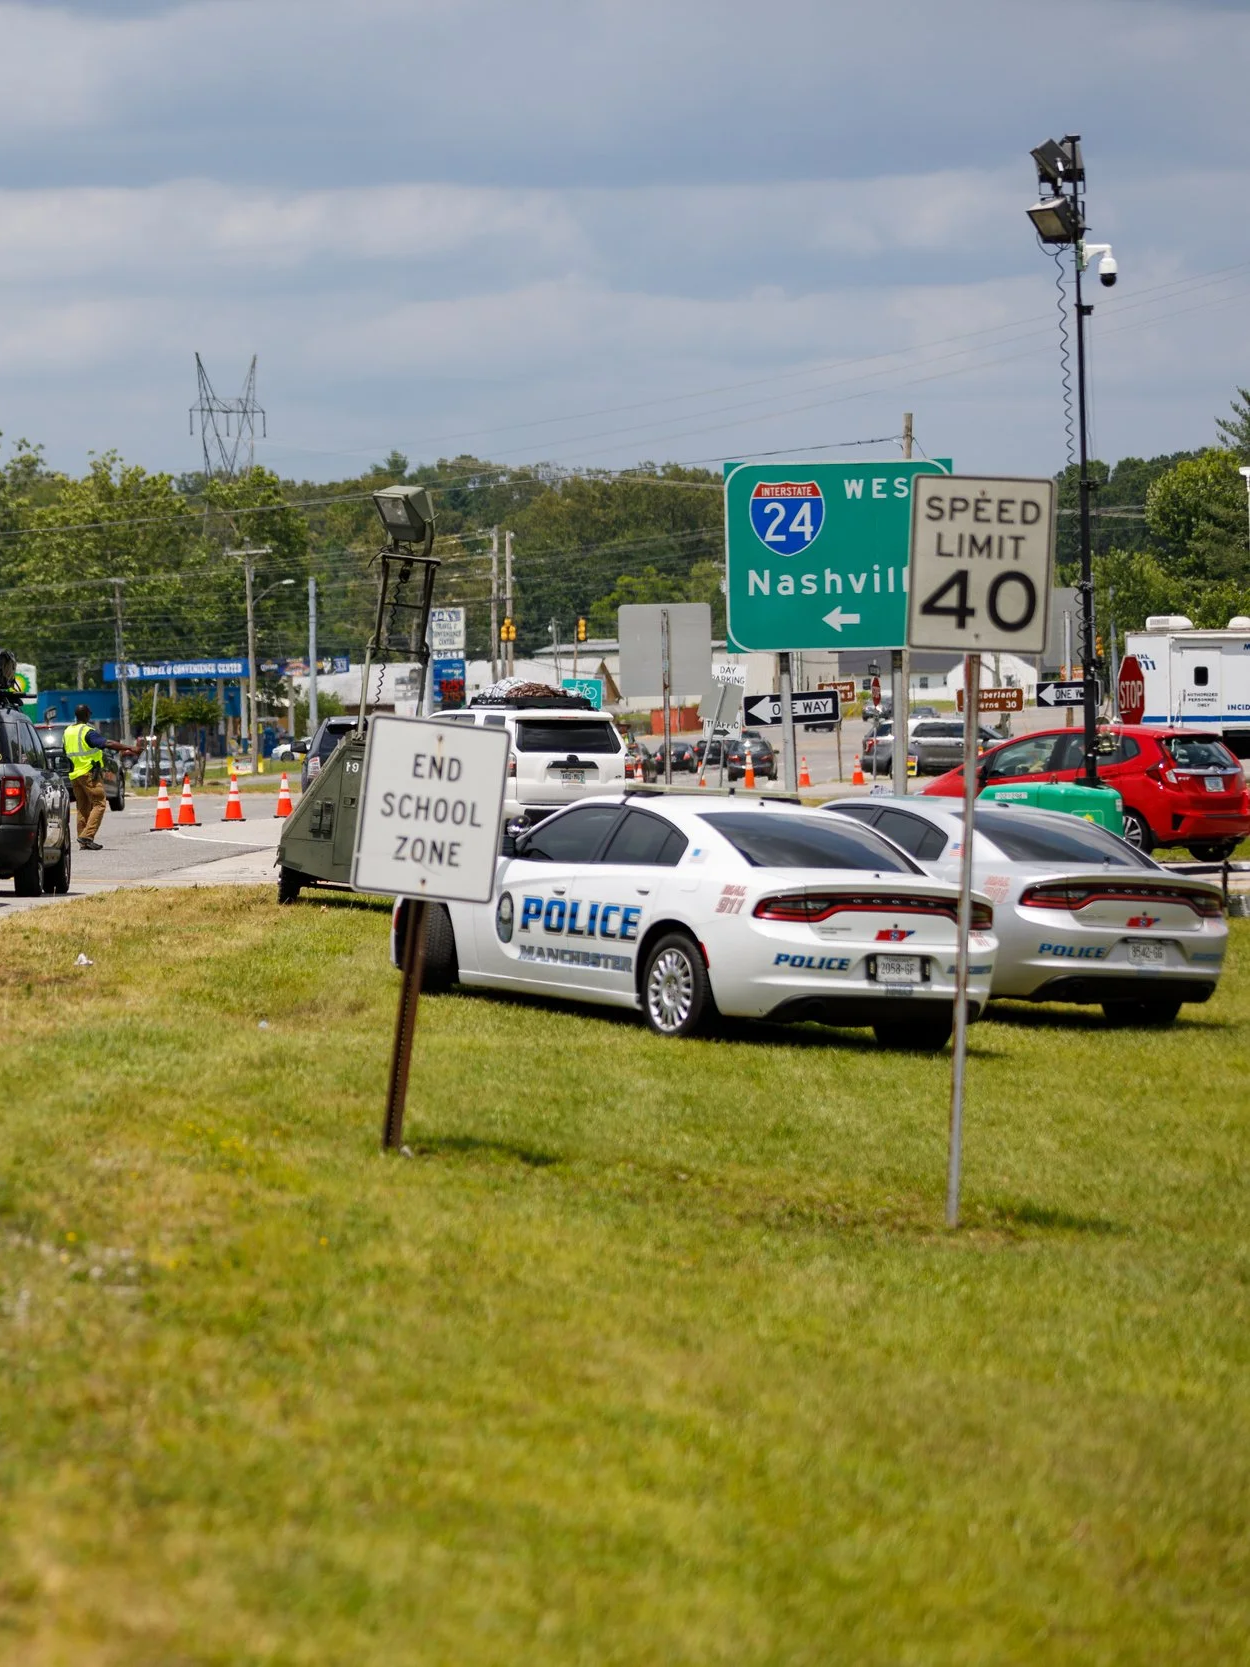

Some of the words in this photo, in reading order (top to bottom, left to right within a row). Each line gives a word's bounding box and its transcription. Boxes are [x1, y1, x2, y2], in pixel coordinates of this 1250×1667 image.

[761, 486, 812, 497] INTERSTATE
[763, 502, 813, 542] 24
[925, 496, 1041, 525] SPEED
[936, 533, 1026, 560] LIMIT
[920, 569, 1037, 632] 40
[720, 666, 737, 674] DAY
[772, 703, 798, 716] OE
[802, 700, 829, 713] WAY
[1005, 701, 1017, 709] 30
[1055, 689, 1072, 699] ONE
[1120, 680, 1143, 709] STOP
[707, 720, 739, 729] TAFFIC
[412, 753, 462, 782] END
[381, 792, 482, 828] SCHOOL
[392, 836, 461, 868] ZONE
[518, 894, 643, 944] POLICE
[518, 944, 633, 973] MANCHESTER
[773, 952, 851, 972] POLICE
[1038, 942, 1107, 958] POLICE
